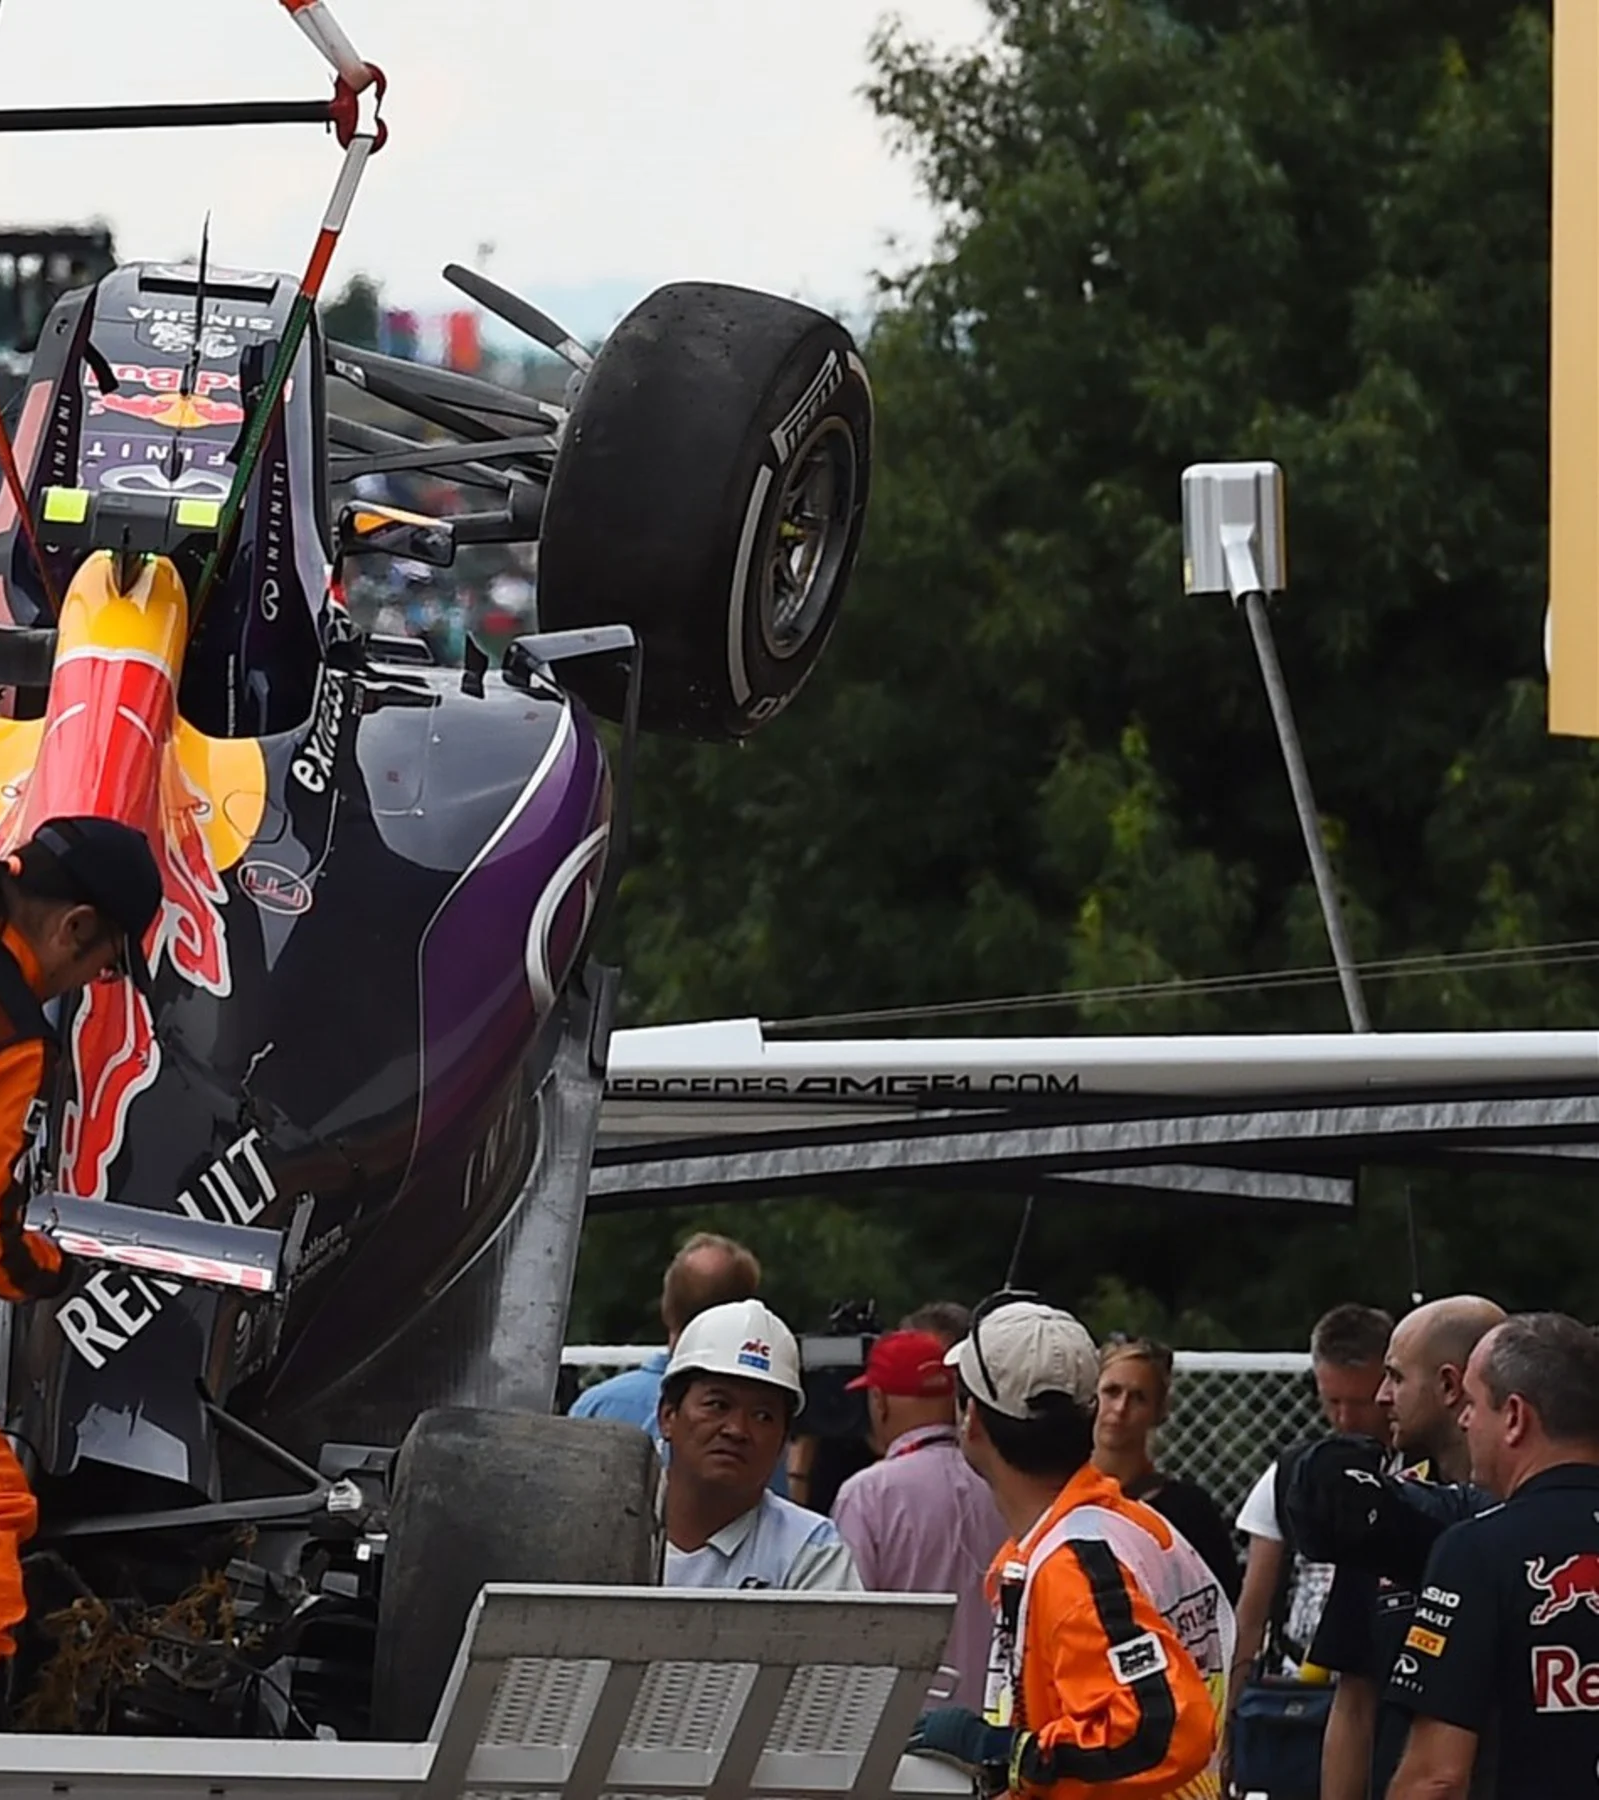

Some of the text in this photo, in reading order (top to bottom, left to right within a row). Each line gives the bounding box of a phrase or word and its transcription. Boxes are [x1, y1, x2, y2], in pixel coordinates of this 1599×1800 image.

[53, 394, 73, 478] INFINI
[86, 441, 227, 466] FINIT
[265, 461, 286, 573] INFINITI
[1415, 1607, 1453, 1628] AULT
[1531, 1645, 1599, 1713] Re
